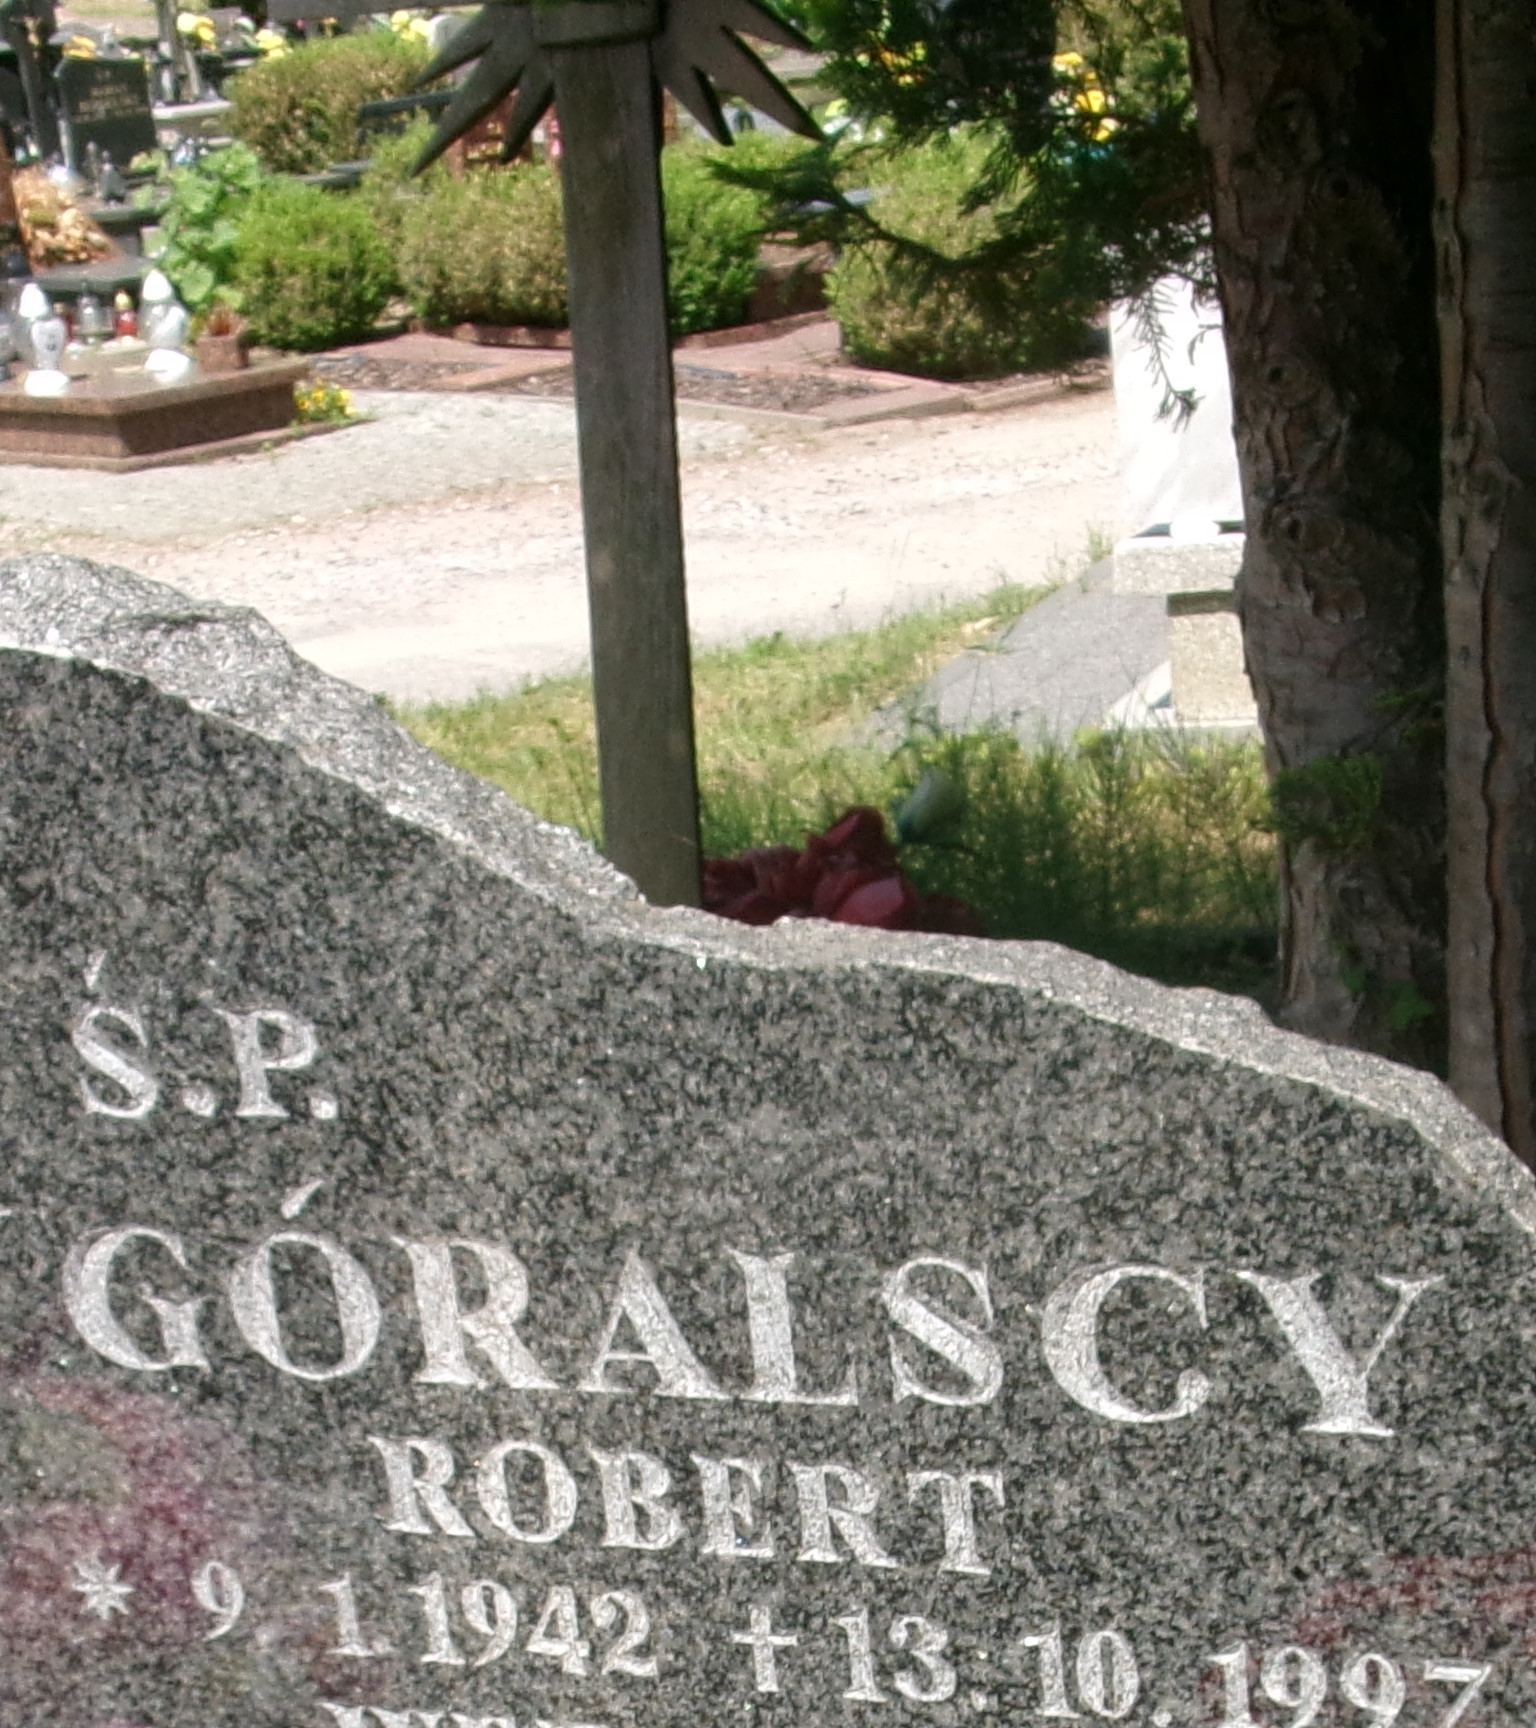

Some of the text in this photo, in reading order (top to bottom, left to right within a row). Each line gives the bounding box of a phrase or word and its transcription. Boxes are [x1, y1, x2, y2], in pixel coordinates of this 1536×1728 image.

[72, 950, 339, 1122] Ś.P.
[61, 1178, 1444, 1438] GÓRALSCY
[366, 1434, 1006, 1576] ROBERT
